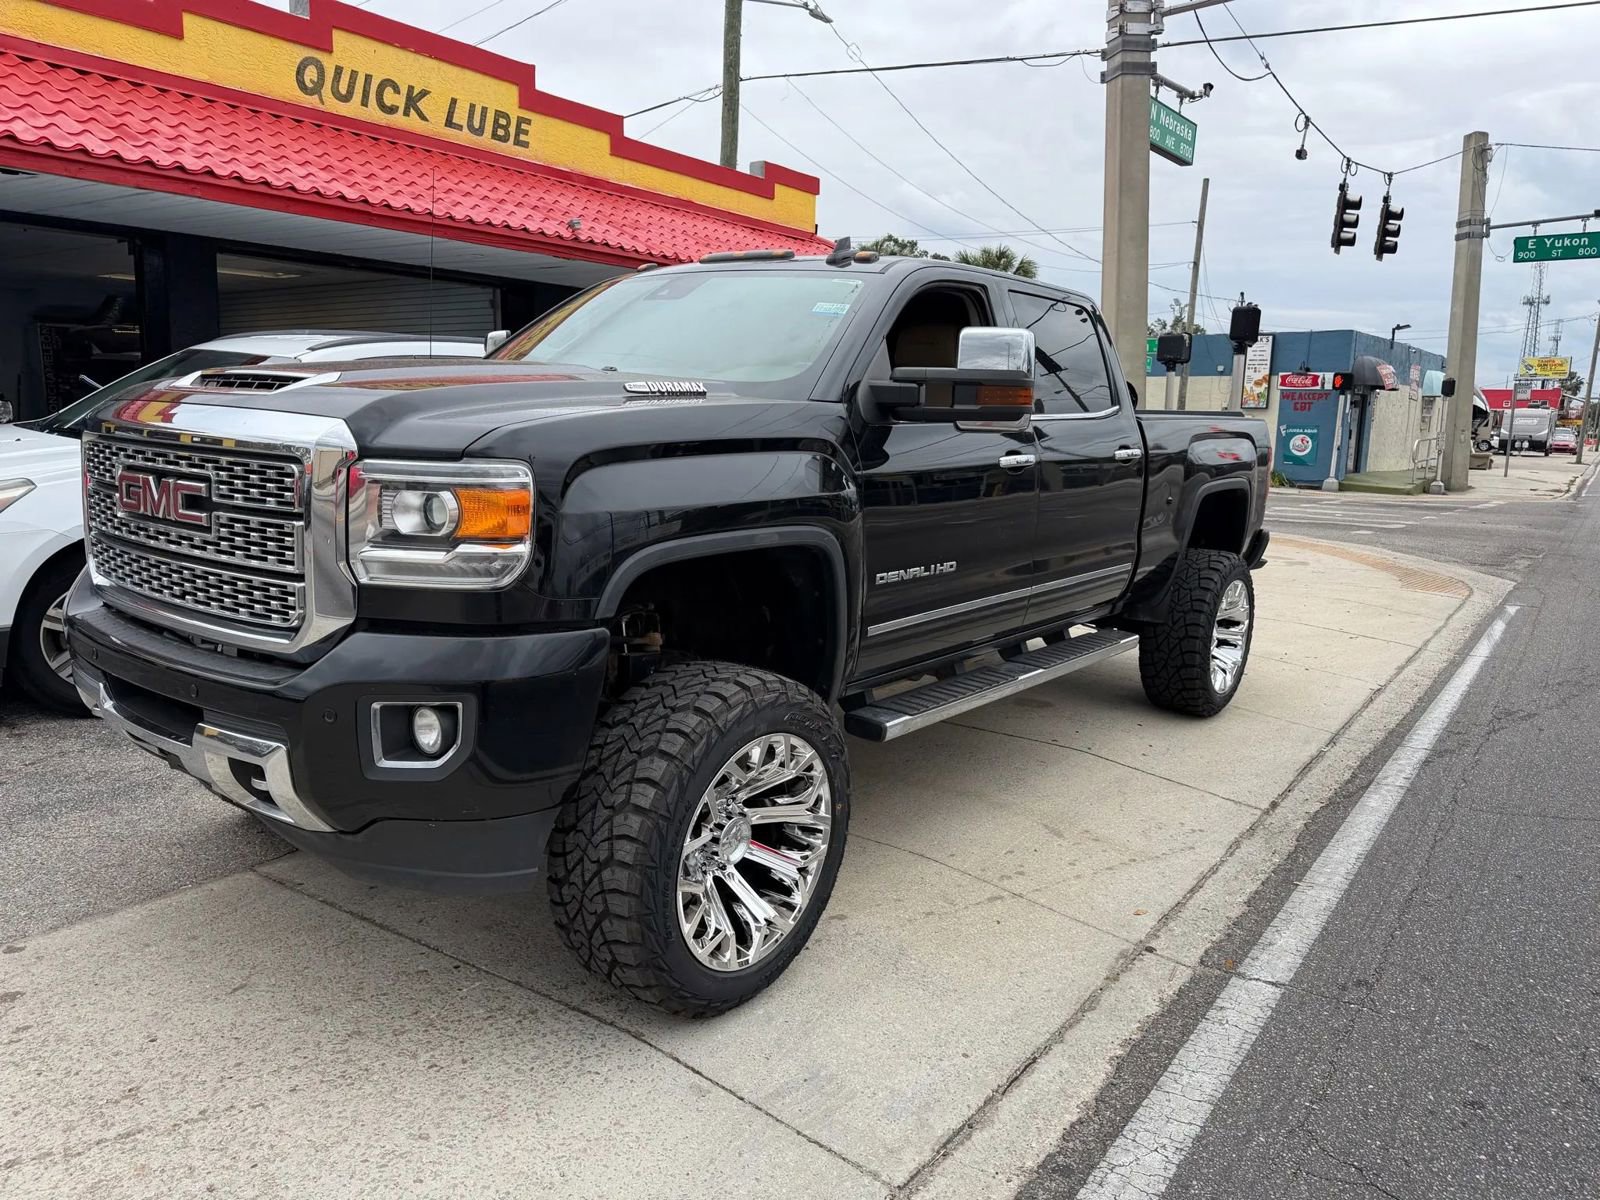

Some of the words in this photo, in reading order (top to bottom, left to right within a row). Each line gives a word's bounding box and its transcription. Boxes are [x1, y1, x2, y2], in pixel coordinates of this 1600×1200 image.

[295, 56, 431, 122] QUICK
[444, 97, 532, 149] LUBE
[1150, 103, 1158, 121] N
[1160, 108, 1193, 141] Nebraska
[1165, 135, 1176, 150] AVE
[1180, 142, 1193, 159] 8700
[1527, 239, 1537, 249] E
[1544, 237, 1589, 248] Yukon
[1517, 251, 1537, 259] 900
[1551, 249, 1563, 257] ST
[1577, 247, 1598, 256] 800
[647, 381, 707, 393] DURAMAX
[1281, 392, 1296, 400] WE
[1296, 392, 1331, 401] ACCEPT
[1293, 402, 1314, 412] EBT
[118, 470, 210, 526] GMC
[875, 564, 935, 585] DENALI
[935, 561, 957, 575] HD
